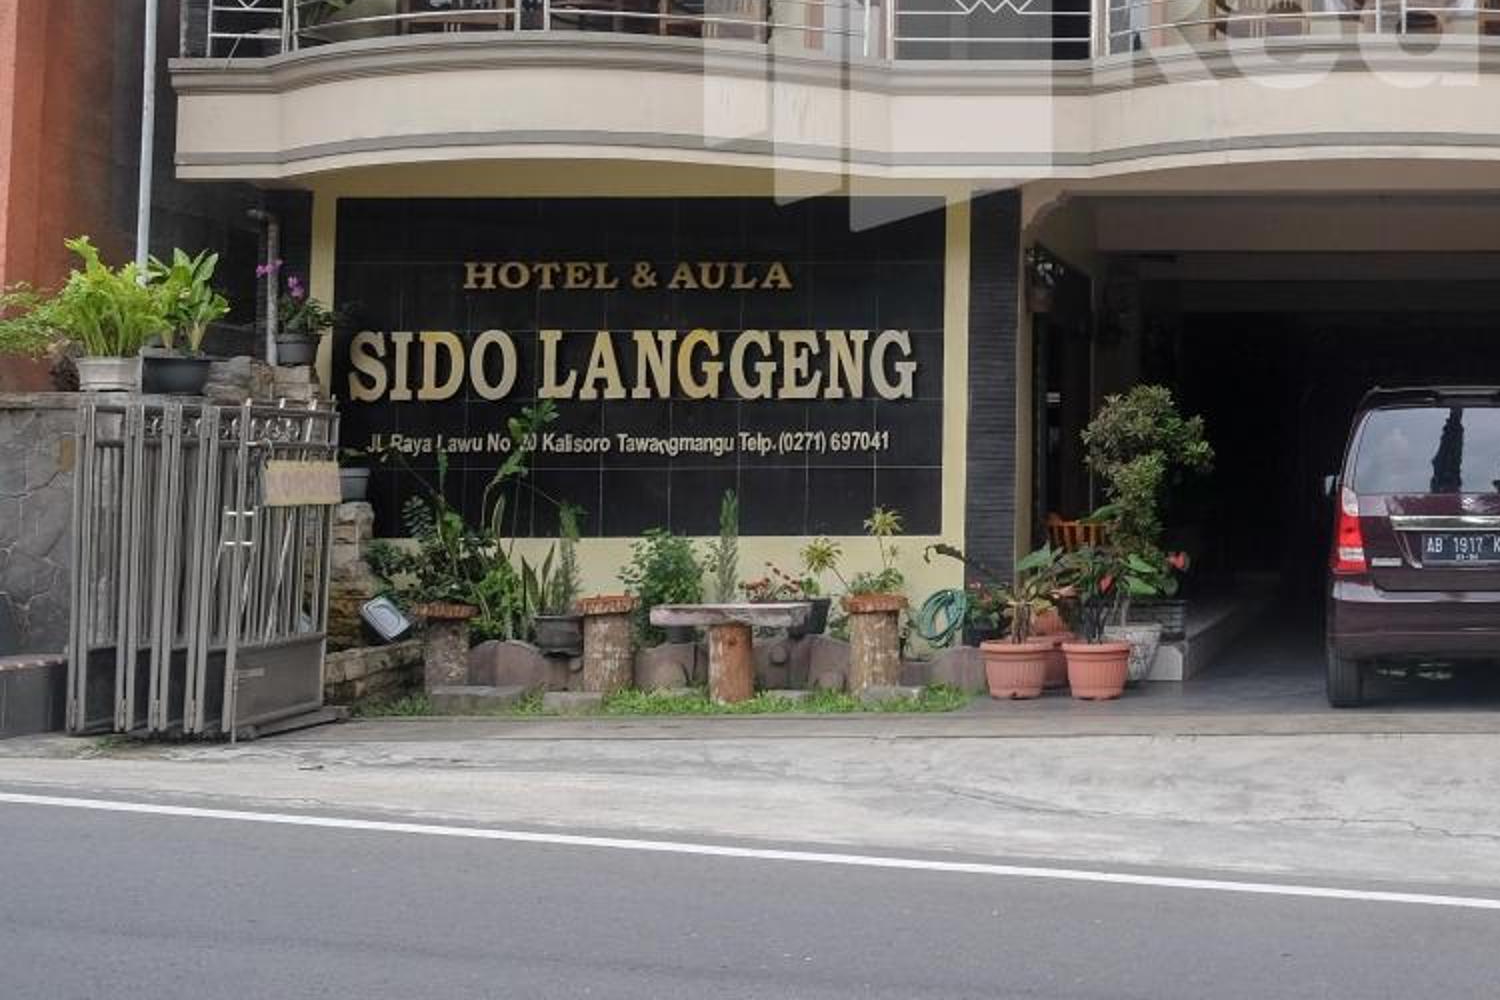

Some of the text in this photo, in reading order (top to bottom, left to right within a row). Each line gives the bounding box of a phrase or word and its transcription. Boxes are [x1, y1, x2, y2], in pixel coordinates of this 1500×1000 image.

[463, 261, 794, 290] HOTEL & AULA
[347, 328, 917, 402] SIDO LANGGENG
[390, 433, 432, 457] Raya
[542, 432, 611, 453] Kalisoro
[615, 433, 735, 457] Tawangmangu
[779, 430, 827, 455] (0271)
[830, 430, 889, 452] 697041
[1427, 537, 1443, 553] AB
[1453, 537, 1483, 553] 1917
